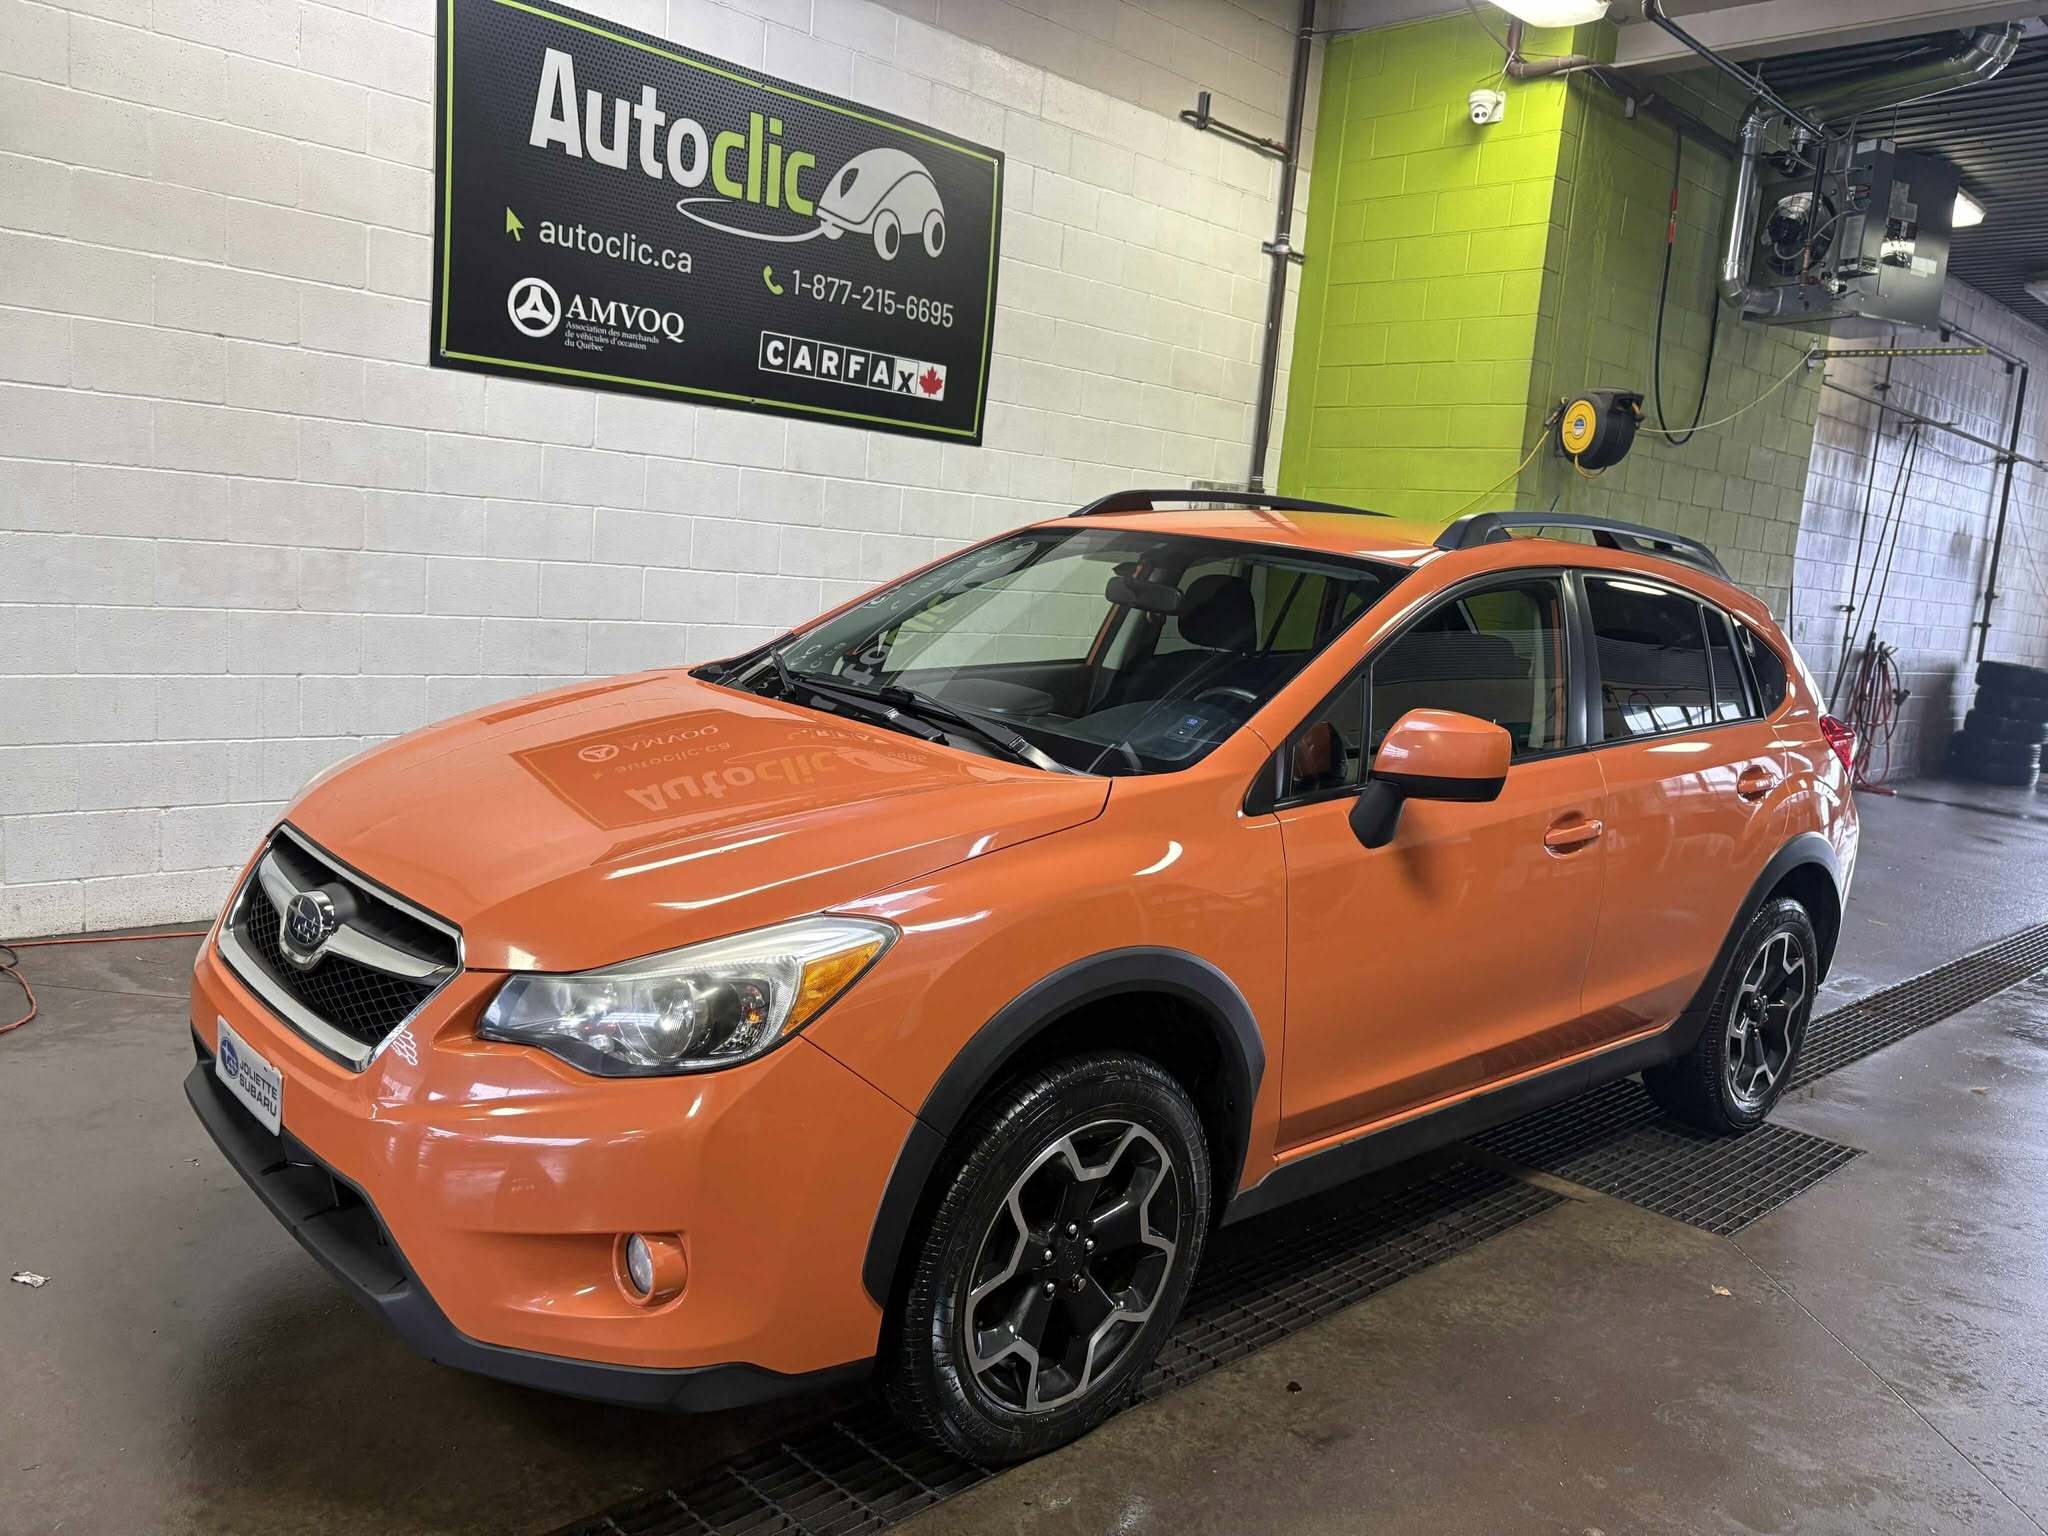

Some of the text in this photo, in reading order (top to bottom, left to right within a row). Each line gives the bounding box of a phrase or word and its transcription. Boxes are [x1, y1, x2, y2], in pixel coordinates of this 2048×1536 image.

[529, 46, 817, 217] Autoclic
[538, 219, 694, 275] autoclic.ca
[565, 294, 685, 343] AMVOQ
[792, 269, 955, 328] 1-877-215-6695
[564, 329, 575, 338] de
[576, 332, 609, 344] véhicules
[564, 338, 604, 352] du Québec
[565, 321, 660, 344] Association des marchands
[765, 339, 914, 394] CARFAX
[239, 1060, 278, 1101] JOLIETTE
[239, 1075, 278, 1117] SUBARU
